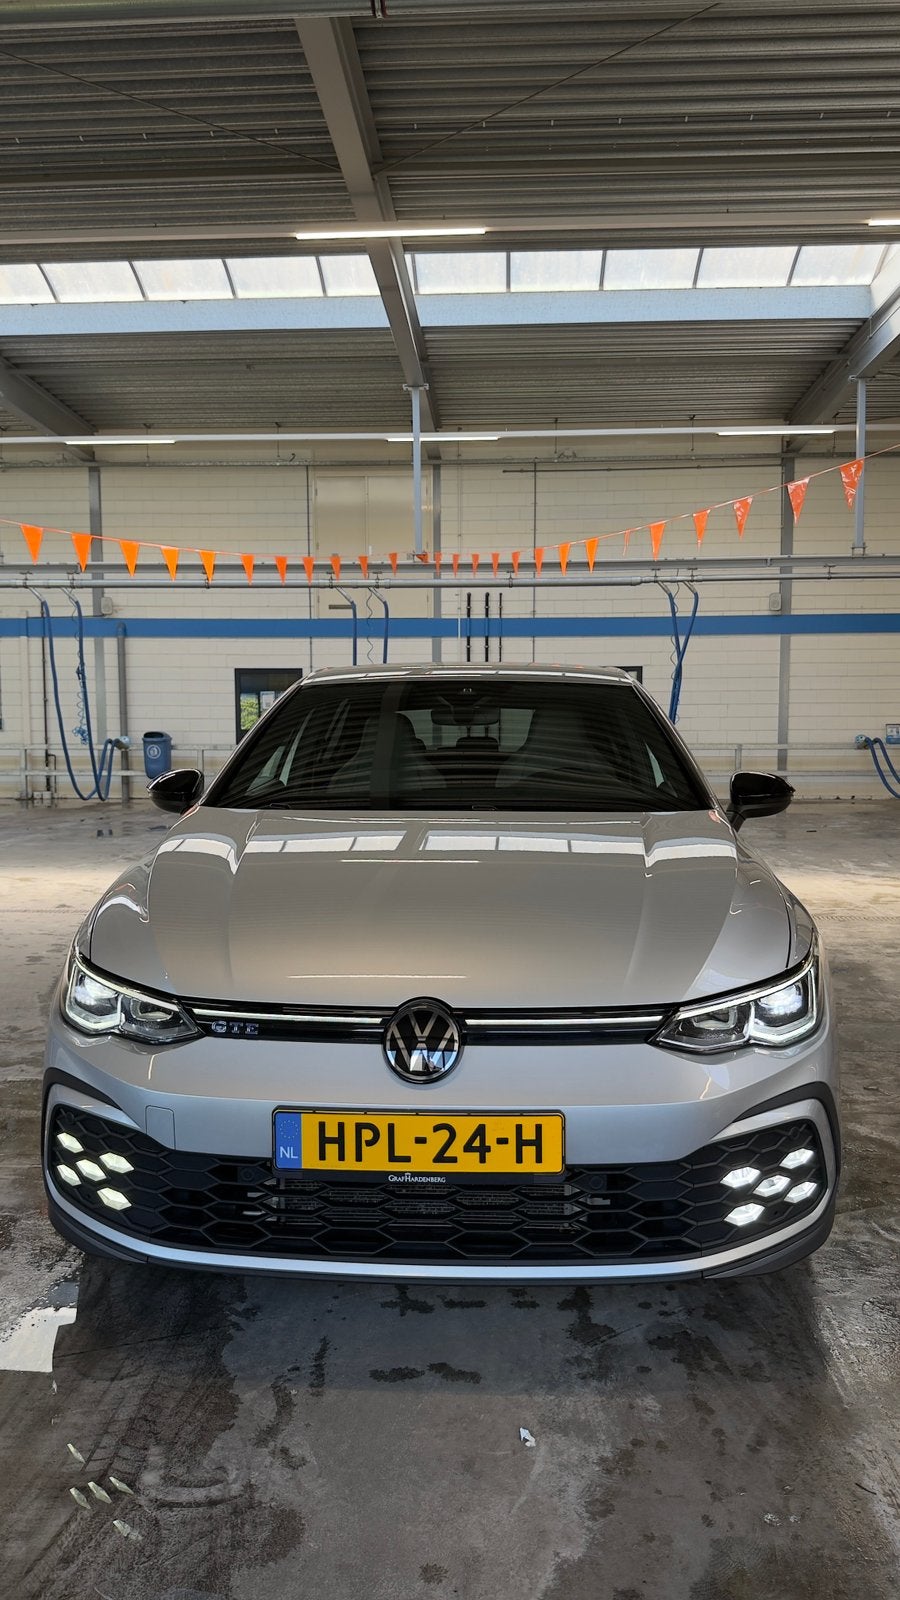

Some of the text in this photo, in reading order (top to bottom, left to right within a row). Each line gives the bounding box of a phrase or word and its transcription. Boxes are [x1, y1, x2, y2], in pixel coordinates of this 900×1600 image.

[211, 1020, 259, 1035] GTE
[317, 1120, 543, 1164] HPL-24-H
[279, 1146, 299, 1159] NL
